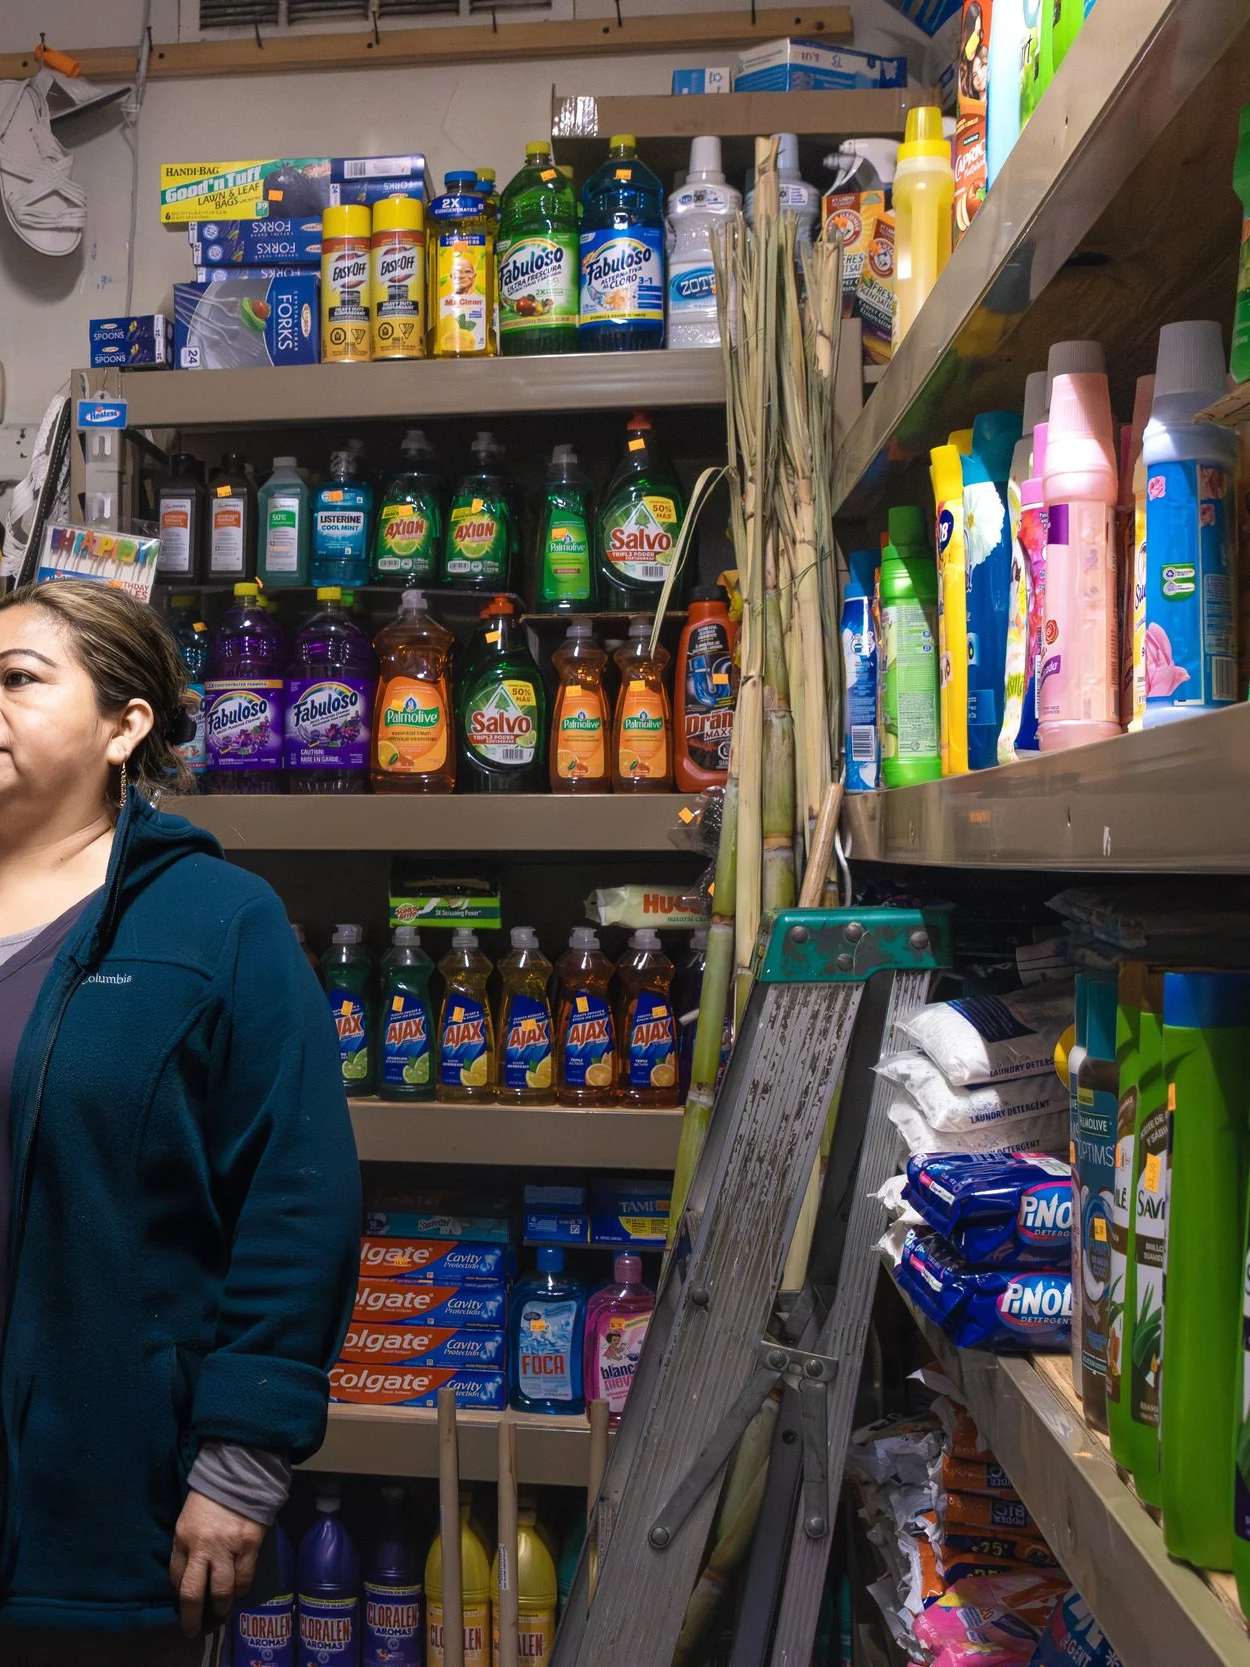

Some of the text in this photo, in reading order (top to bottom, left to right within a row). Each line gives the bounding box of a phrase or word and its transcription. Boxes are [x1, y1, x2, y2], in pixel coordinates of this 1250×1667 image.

[226, 166, 263, 187] Tuff
[197, 182, 261, 206] LAWN & LEAF
[215, 196, 239, 210] BAGS
[442, 198, 460, 209] 2X
[252, 221, 291, 233] FORKS
[256, 242, 296, 254] FORKS
[499, 247, 564, 290] Fabuloso
[586, 247, 652, 287] Fabuloso
[601, 265, 643, 286] ALTERNATIVA
[507, 265, 562, 293] ULTRA FRESCURA
[609, 274, 637, 290] CLORO
[278, 294, 292, 350] FORKS
[94, 331, 125, 341] SPOONS
[95, 355, 126, 364] SPOONS
[189, 350, 198, 364] 24
[272, 513, 286, 521] 50%
[652, 503, 672, 514] 50%
[320, 515, 361, 524] LISTERINE
[385, 518, 425, 541] AXION
[454, 521, 495, 542] AXION
[610, 526, 672, 552] Salvo
[550, 541, 586, 553] Palmolive
[512, 688, 532, 697] 50%
[207, 699, 268, 735] Fabuloso
[293, 691, 360, 728] Fabuloso
[385, 707, 440, 727] Palmolive
[471, 710, 532, 735] Salvo
[563, 719, 600, 731] Palmolive
[625, 719, 662, 731] Palmolive
[686, 711, 734, 739] Dran
[704, 729, 728, 740] MAX
[385, 1018, 425, 1047] AJAX
[445, 1019, 483, 1049] AJAX
[508, 1021, 545, 1050] AJAX
[568, 1018, 608, 1048] AJAX
[633, 1019, 671, 1049] AJAX
[990, 1065, 1025, 1078] LAUNDRY
[970, 1101, 1050, 1124] LAUNDRY DETERGENT
[361, 1243, 431, 1266] lgate
[446, 1252, 482, 1265] Cavity
[444, 1261, 479, 1271] Protection
[356, 1290, 431, 1312] olgate
[447, 1298, 483, 1311] Cavity
[444, 1308, 480, 1318] Protection
[343, 1331, 431, 1354] olgate
[447, 1339, 482, 1352] Cavity
[444, 1348, 480, 1358] Protection
[521, 1354, 566, 1376] FOCA
[328, 1368, 431, 1393] Colgate
[447, 1379, 482, 1392] Cavity
[240, 1611, 292, 1639] CLORALEN
[366, 1602, 419, 1630] CLORALEN
[300, 1615, 351, 1643] CLORALEN
[376, 1626, 412, 1637] AROMAS
[249, 1637, 286, 1648] AROMAS
[306, 1639, 343, 1650] AROMAS
